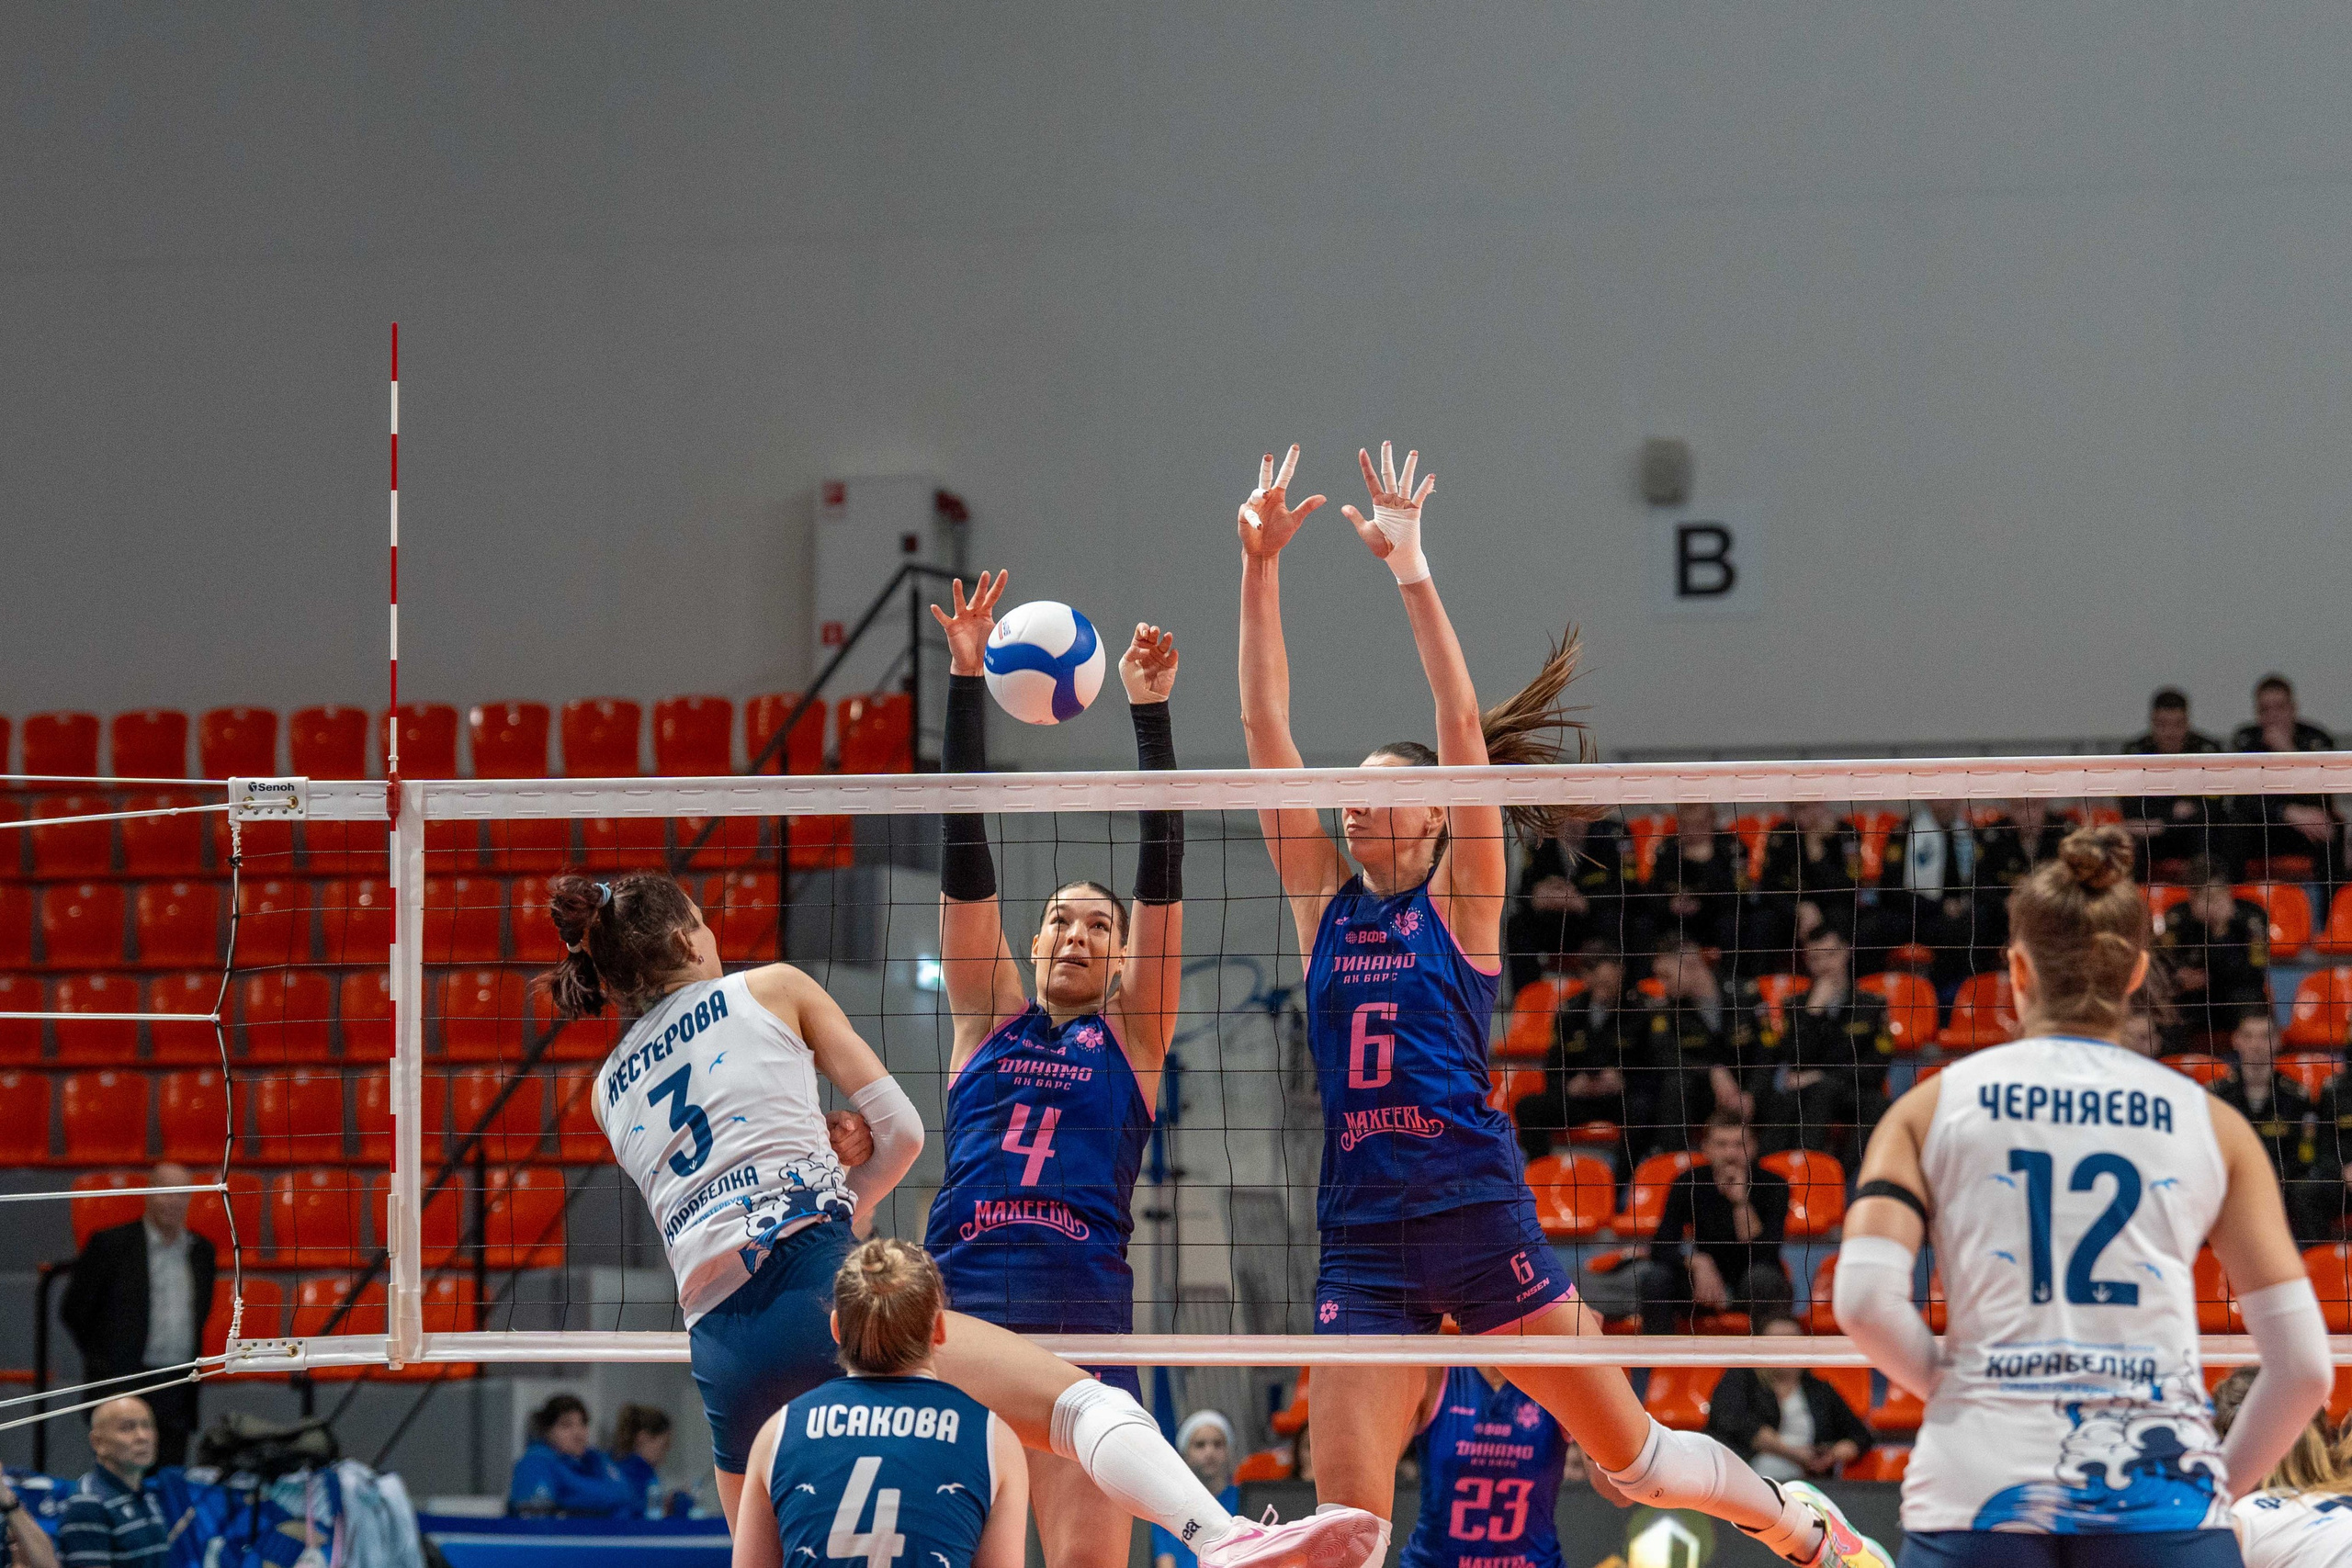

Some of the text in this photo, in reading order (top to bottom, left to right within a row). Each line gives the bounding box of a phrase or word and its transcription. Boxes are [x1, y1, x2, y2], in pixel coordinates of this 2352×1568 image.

[258, 783, 295, 792] Senoh
[1358, 931, 1387, 944] ВФВ
[607, 989, 729, 1109] НЕСТЕРОВА
[996, 1057, 1093, 1082] ДИНАМО
[1348, 1001, 1398, 1089] 6
[647, 1062, 714, 1178] 3
[1979, 1082, 2174, 1134] ЧЕРНЯЕВА
[1001, 1102, 1062, 1187] 4
[664, 1165, 759, 1248] КОРАБЕЛКА
[2008, 1148, 2142, 1306] 12
[1510, 1251, 1535, 1285] 6
[1985, 1352, 2156, 1384] КОРАБЕЛКА
[806, 1404, 960, 1444] ИСАКОВА
[827, 1456, 906, 1568] 4
[1449, 1476, 1535, 1541] 23
